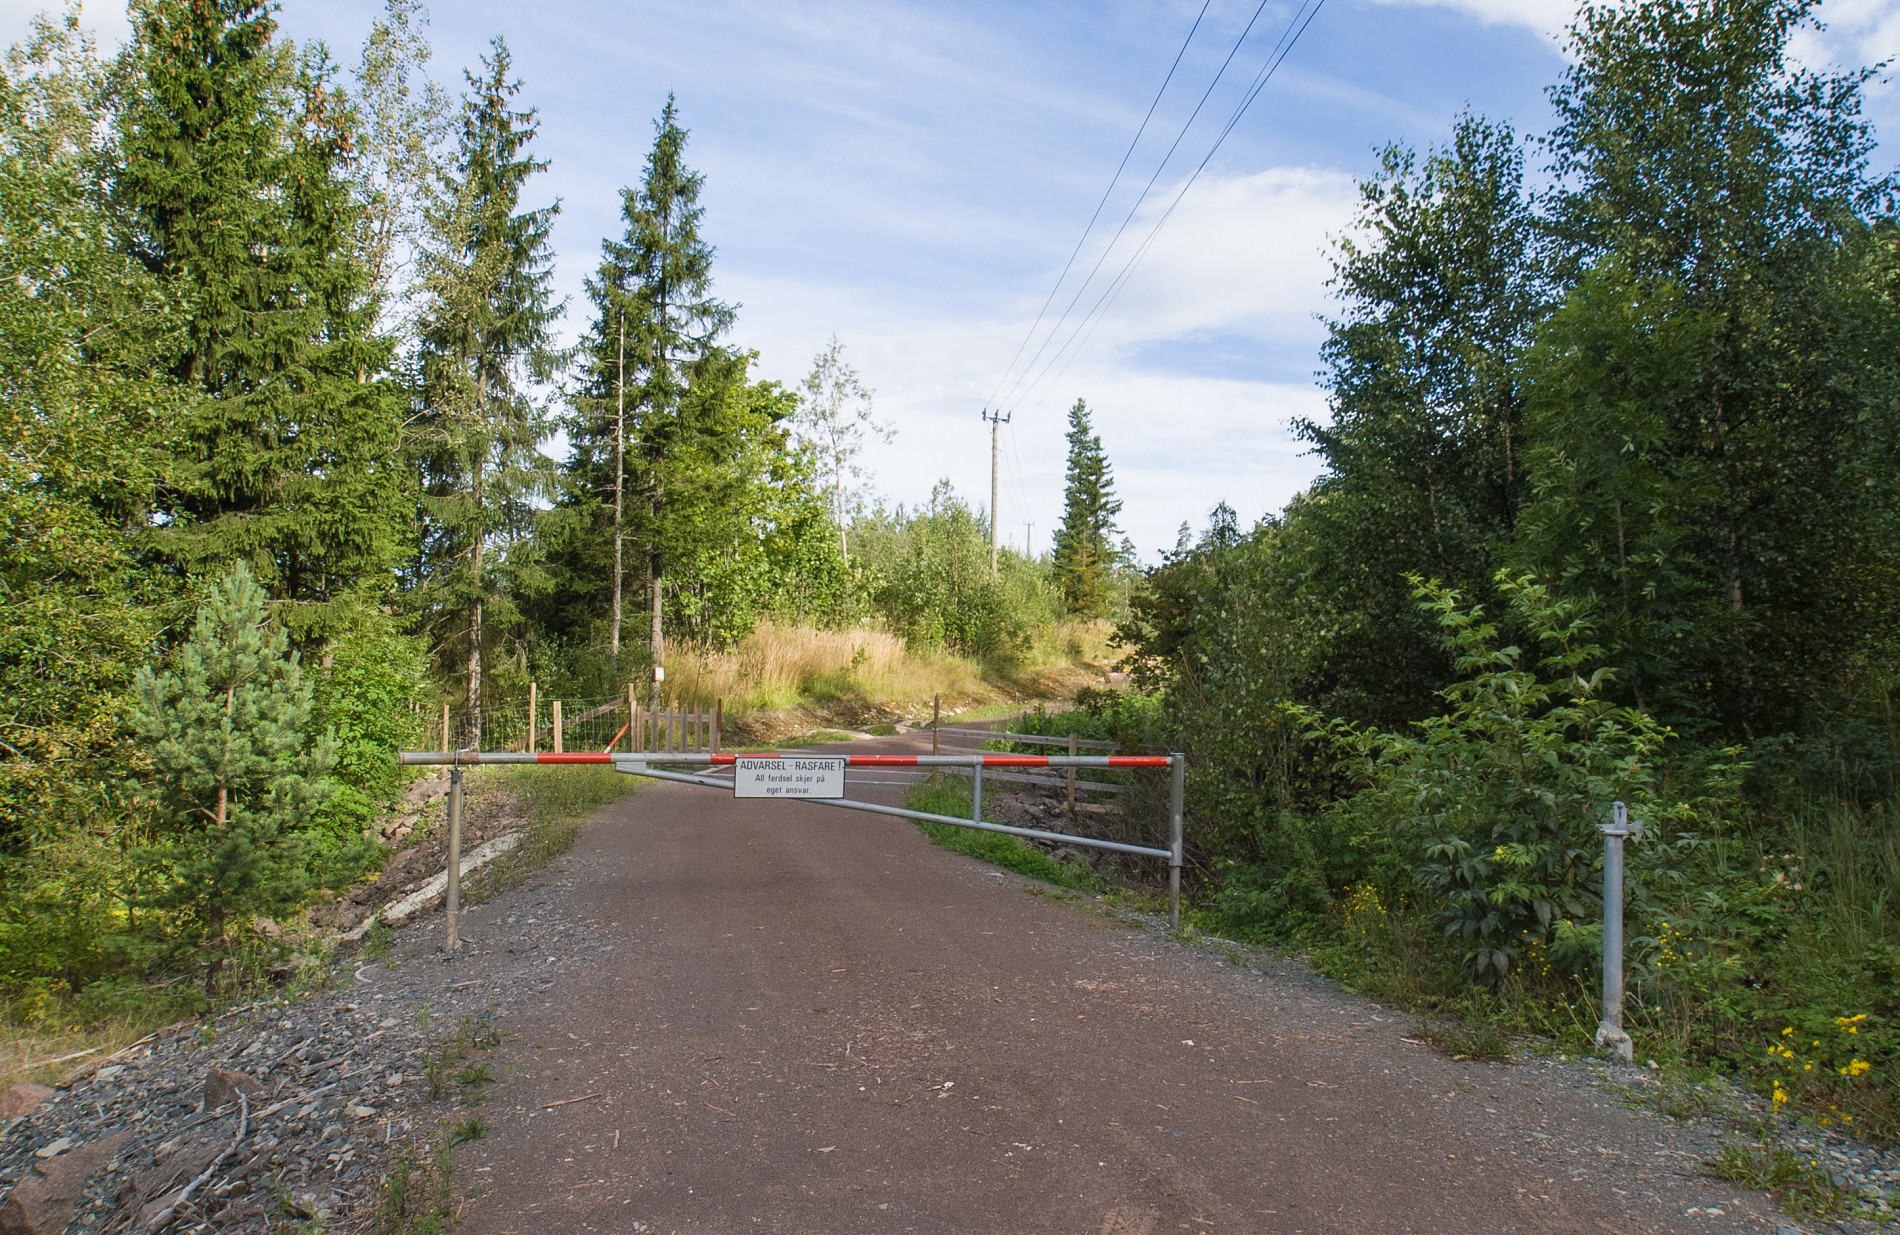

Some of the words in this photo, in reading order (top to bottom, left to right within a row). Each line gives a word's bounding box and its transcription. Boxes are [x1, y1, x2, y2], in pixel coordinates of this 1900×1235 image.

[740, 760, 787, 770] ADVARSEL
[795, 761, 835, 771] RASFARE
[755, 774, 765, 782] All
[768, 774, 793, 782] ferdsel
[796, 774, 813, 783] skjer
[816, 775, 825, 784] på
[766, 787, 782, 795] eget
